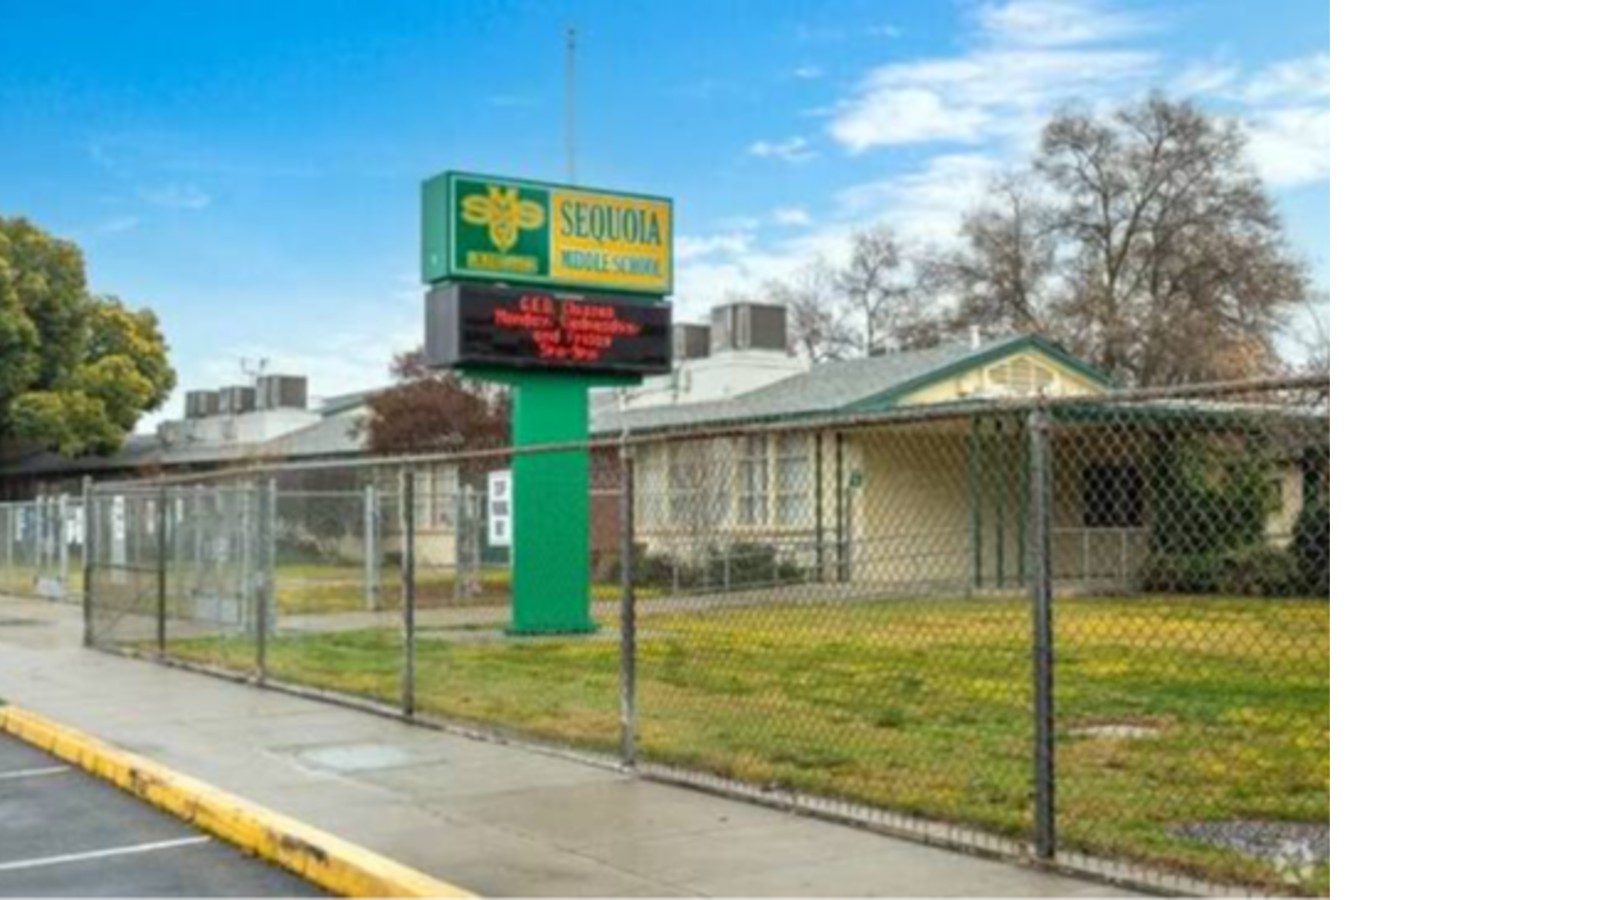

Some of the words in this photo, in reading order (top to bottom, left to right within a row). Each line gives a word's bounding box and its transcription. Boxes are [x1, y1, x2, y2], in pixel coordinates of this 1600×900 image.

[560, 201, 662, 247] SEQUOIA
[561, 249, 609, 273] MIDDLE
[611, 255, 661, 278] SCHOOL
